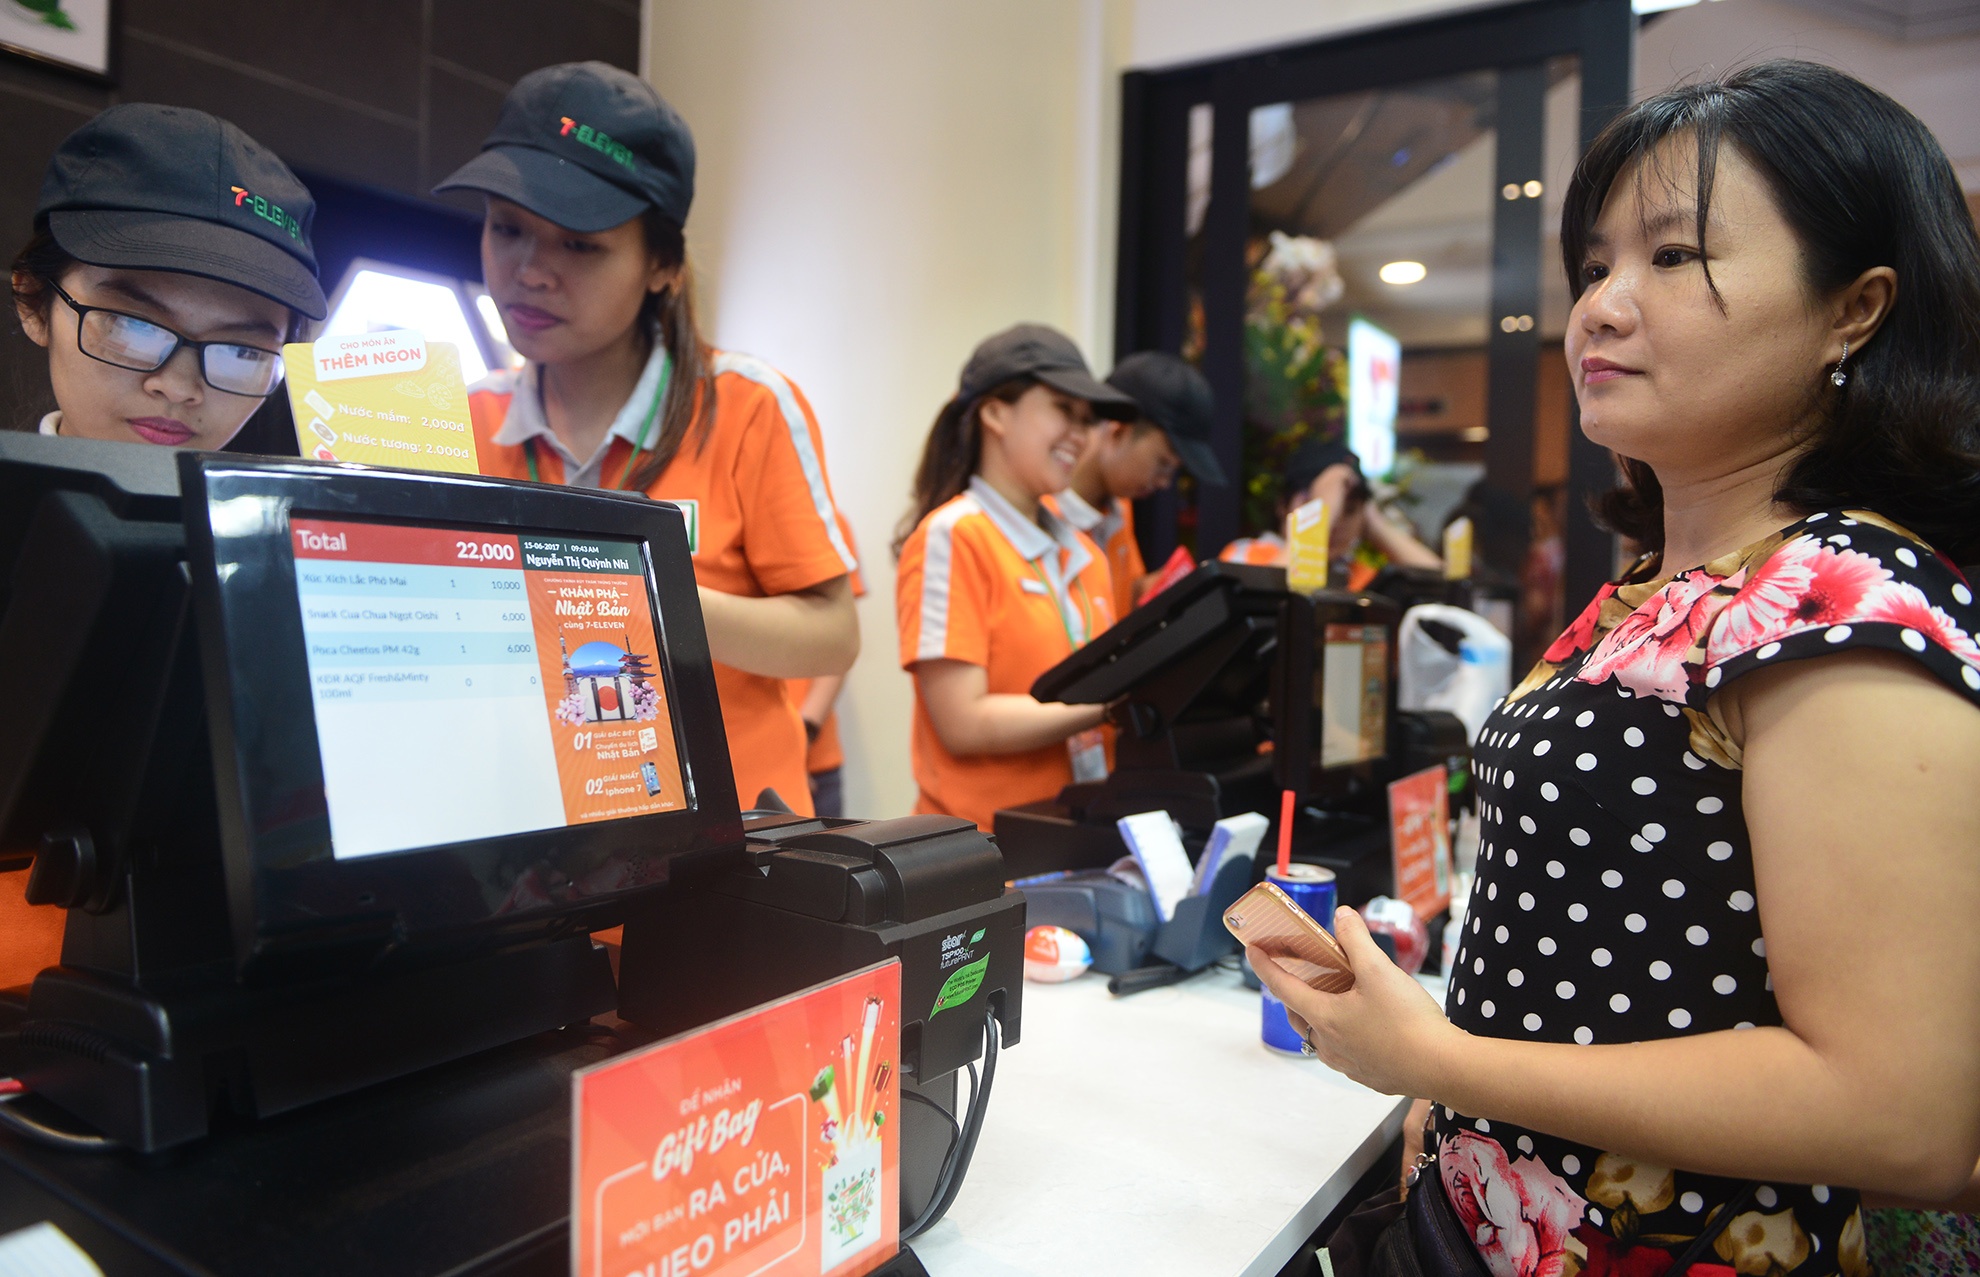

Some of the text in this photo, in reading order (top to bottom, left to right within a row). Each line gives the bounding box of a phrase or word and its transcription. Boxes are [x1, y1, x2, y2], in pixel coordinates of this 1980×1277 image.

[340, 337, 396, 350] CHO MÓN ĂN
[320, 348, 421, 371] THÊM NGON
[338, 403, 373, 419] Nước
[377, 410, 412, 425] mắm:
[343, 432, 378, 446] Nước
[381, 437, 422, 454] tương:
[296, 529, 515, 562] Total 22,000
[524, 542, 560, 551] 15-06-2017
[571, 545, 588, 553] 09:43
[526, 553, 630, 570] Nguyễn Thị Quỳnh Nhi
[389, 576, 407, 586] Mai
[450, 579, 456, 588] 1
[491, 580, 520, 590] 10,000
[362, 610, 387, 620] Chua
[456, 612, 461, 620] 1
[501, 612, 526, 622] 6,000
[555, 599, 630, 620] Nhật Bản
[564, 620, 625, 629] cùng 7-ELEVEN
[382, 645, 399, 654] PM
[401, 645, 420, 656] 42g
[461, 645, 466, 653] 1
[507, 644, 531, 653] 6,000
[530, 676, 536, 685] 0
[574, 731, 592, 750] 01
[597, 748, 640, 760] Nhật Bản
[585, 777, 603, 796] 02
[636, 784, 642, 792] 7
[942, 935, 964, 951] star
[942, 947, 965, 960] TSP100
[652, 1098, 763, 1181] Gift Bag
[689, 1179, 727, 1220] RA
[625, 1188, 790, 1277] UEO PHẢI
